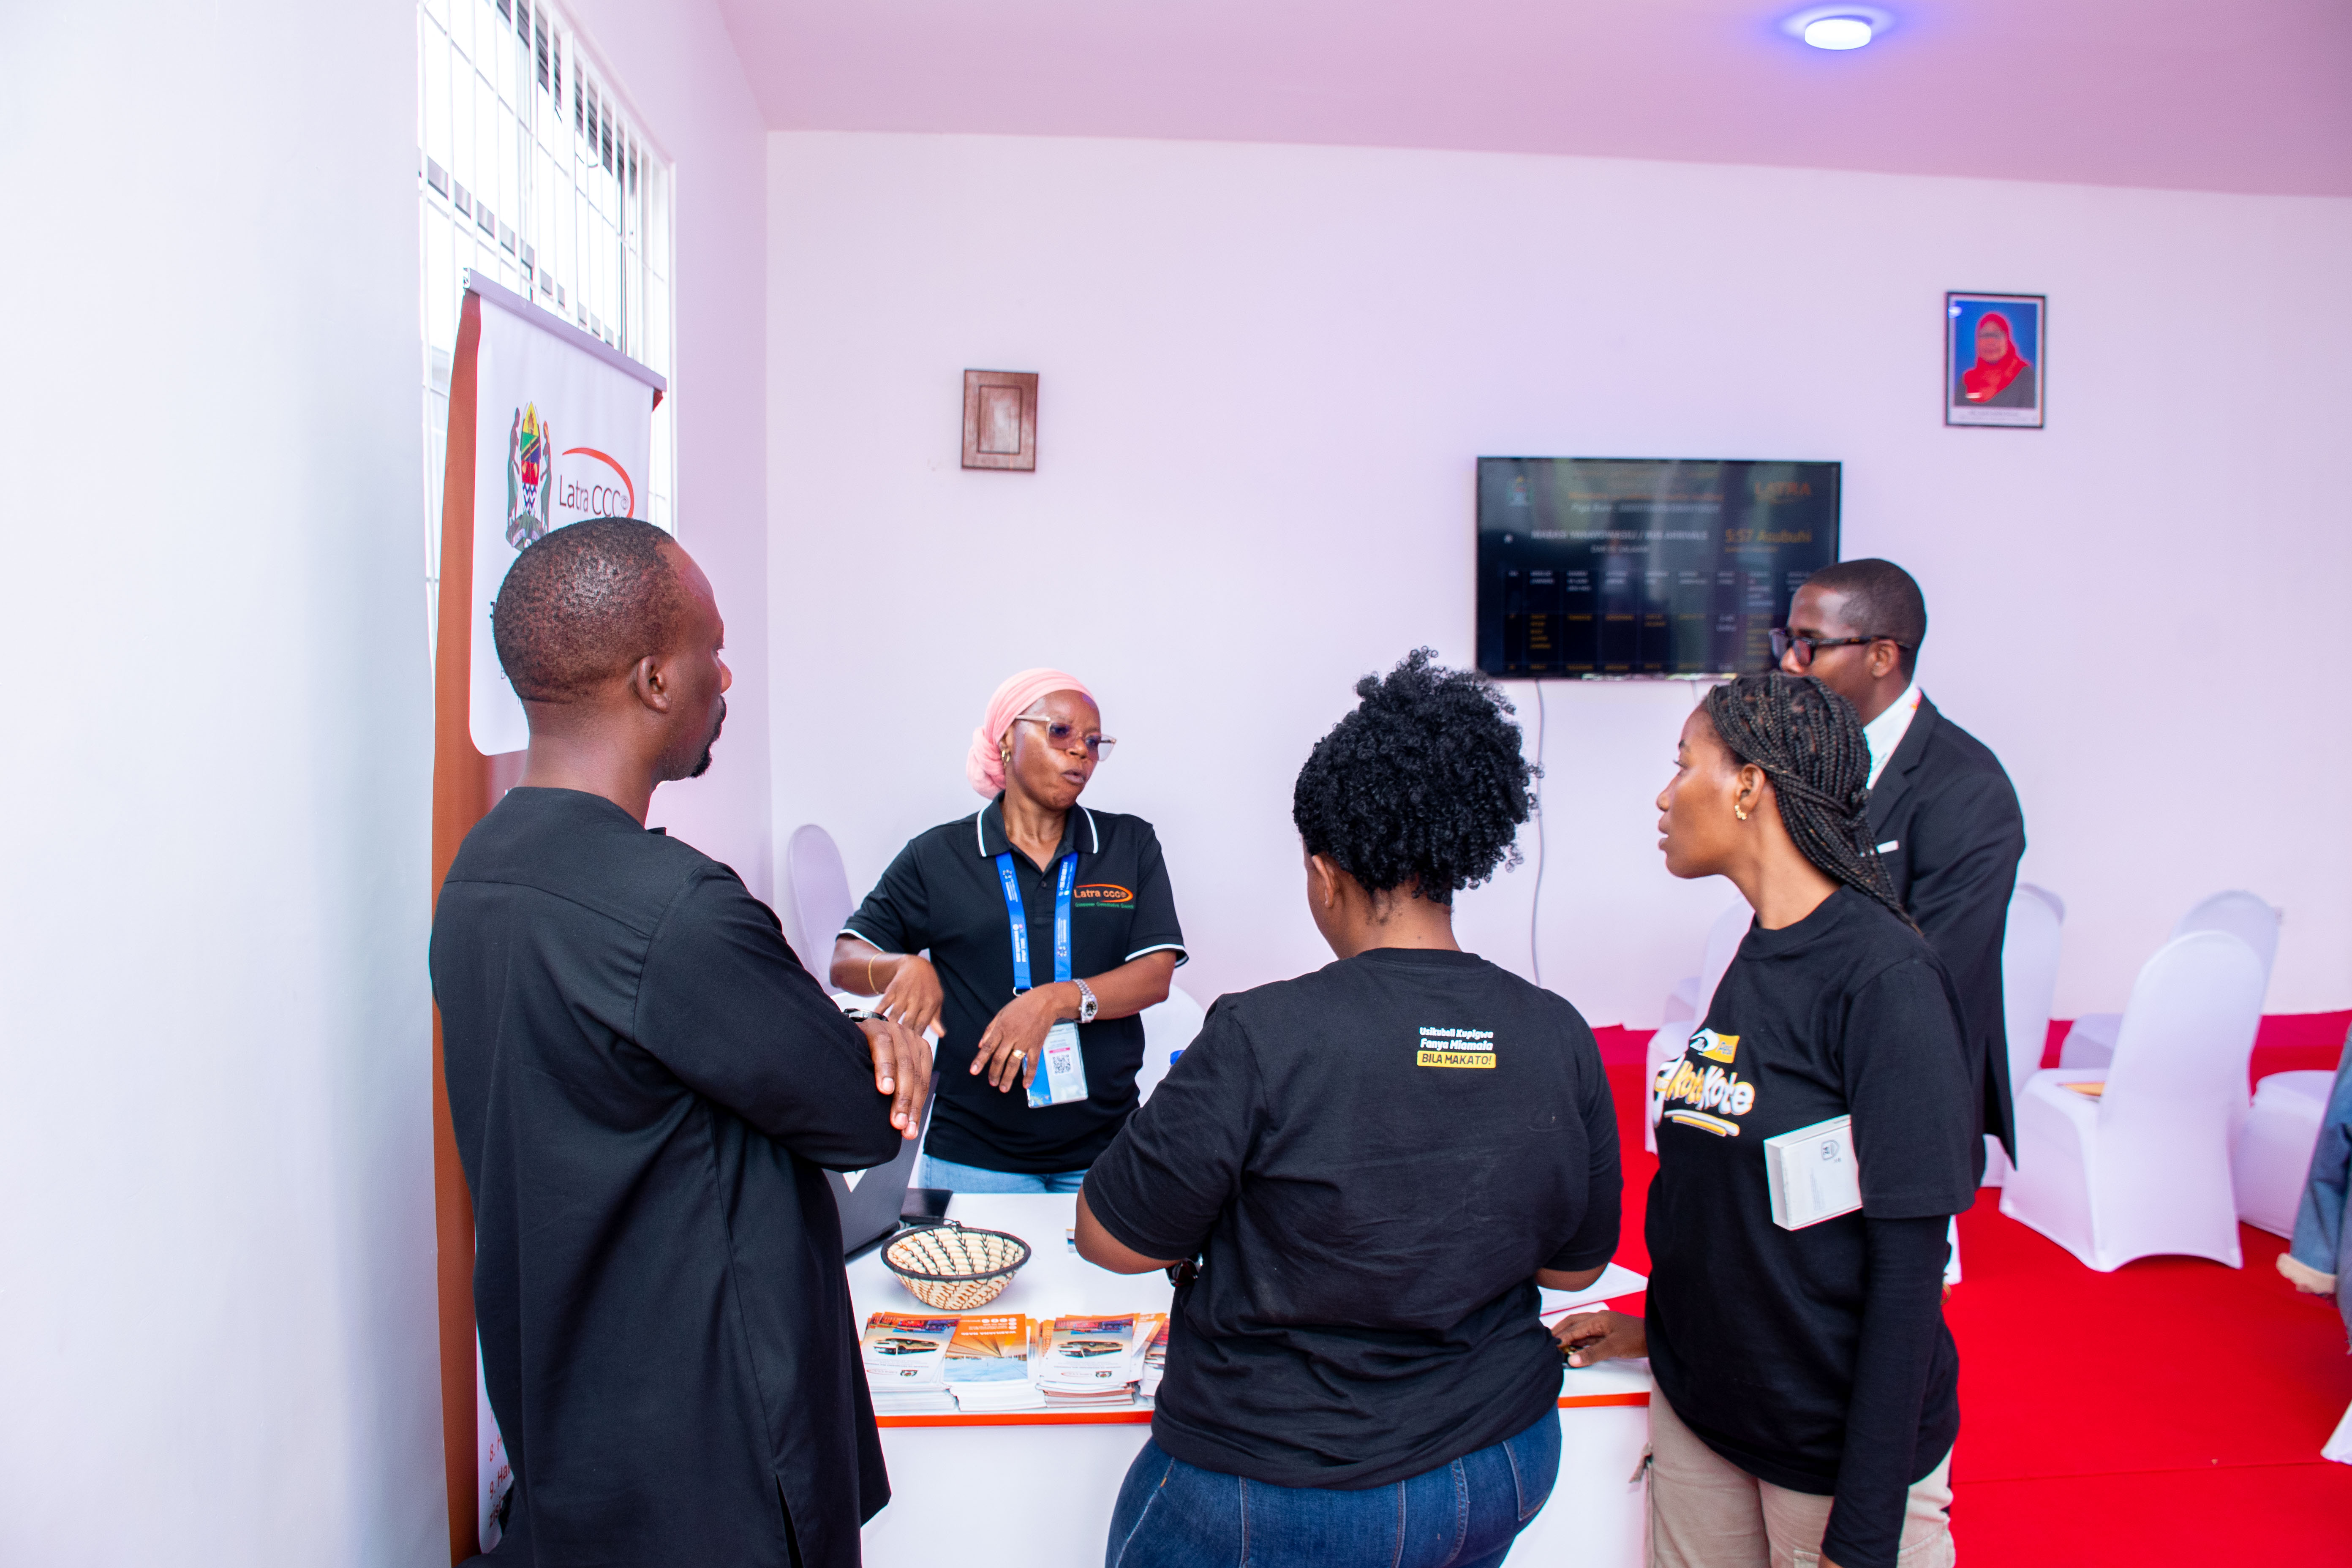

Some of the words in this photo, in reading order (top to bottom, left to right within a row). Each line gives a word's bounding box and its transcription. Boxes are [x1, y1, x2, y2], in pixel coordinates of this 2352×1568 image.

[559, 474, 589, 513] Latra
[1755, 481, 1812, 496] LATRA
[1073, 889, 1101, 898] Latra
[1419, 1027, 1455, 1037] Usikubali
[1456, 1029, 1494, 1040] Kupigwa
[1420, 1038, 1449, 1051] Fanya
[1449, 1039, 1493, 1051] Miamala
[1421, 1054, 1443, 1064] BILA
[1445, 1054, 1492, 1065] MAKATO!
